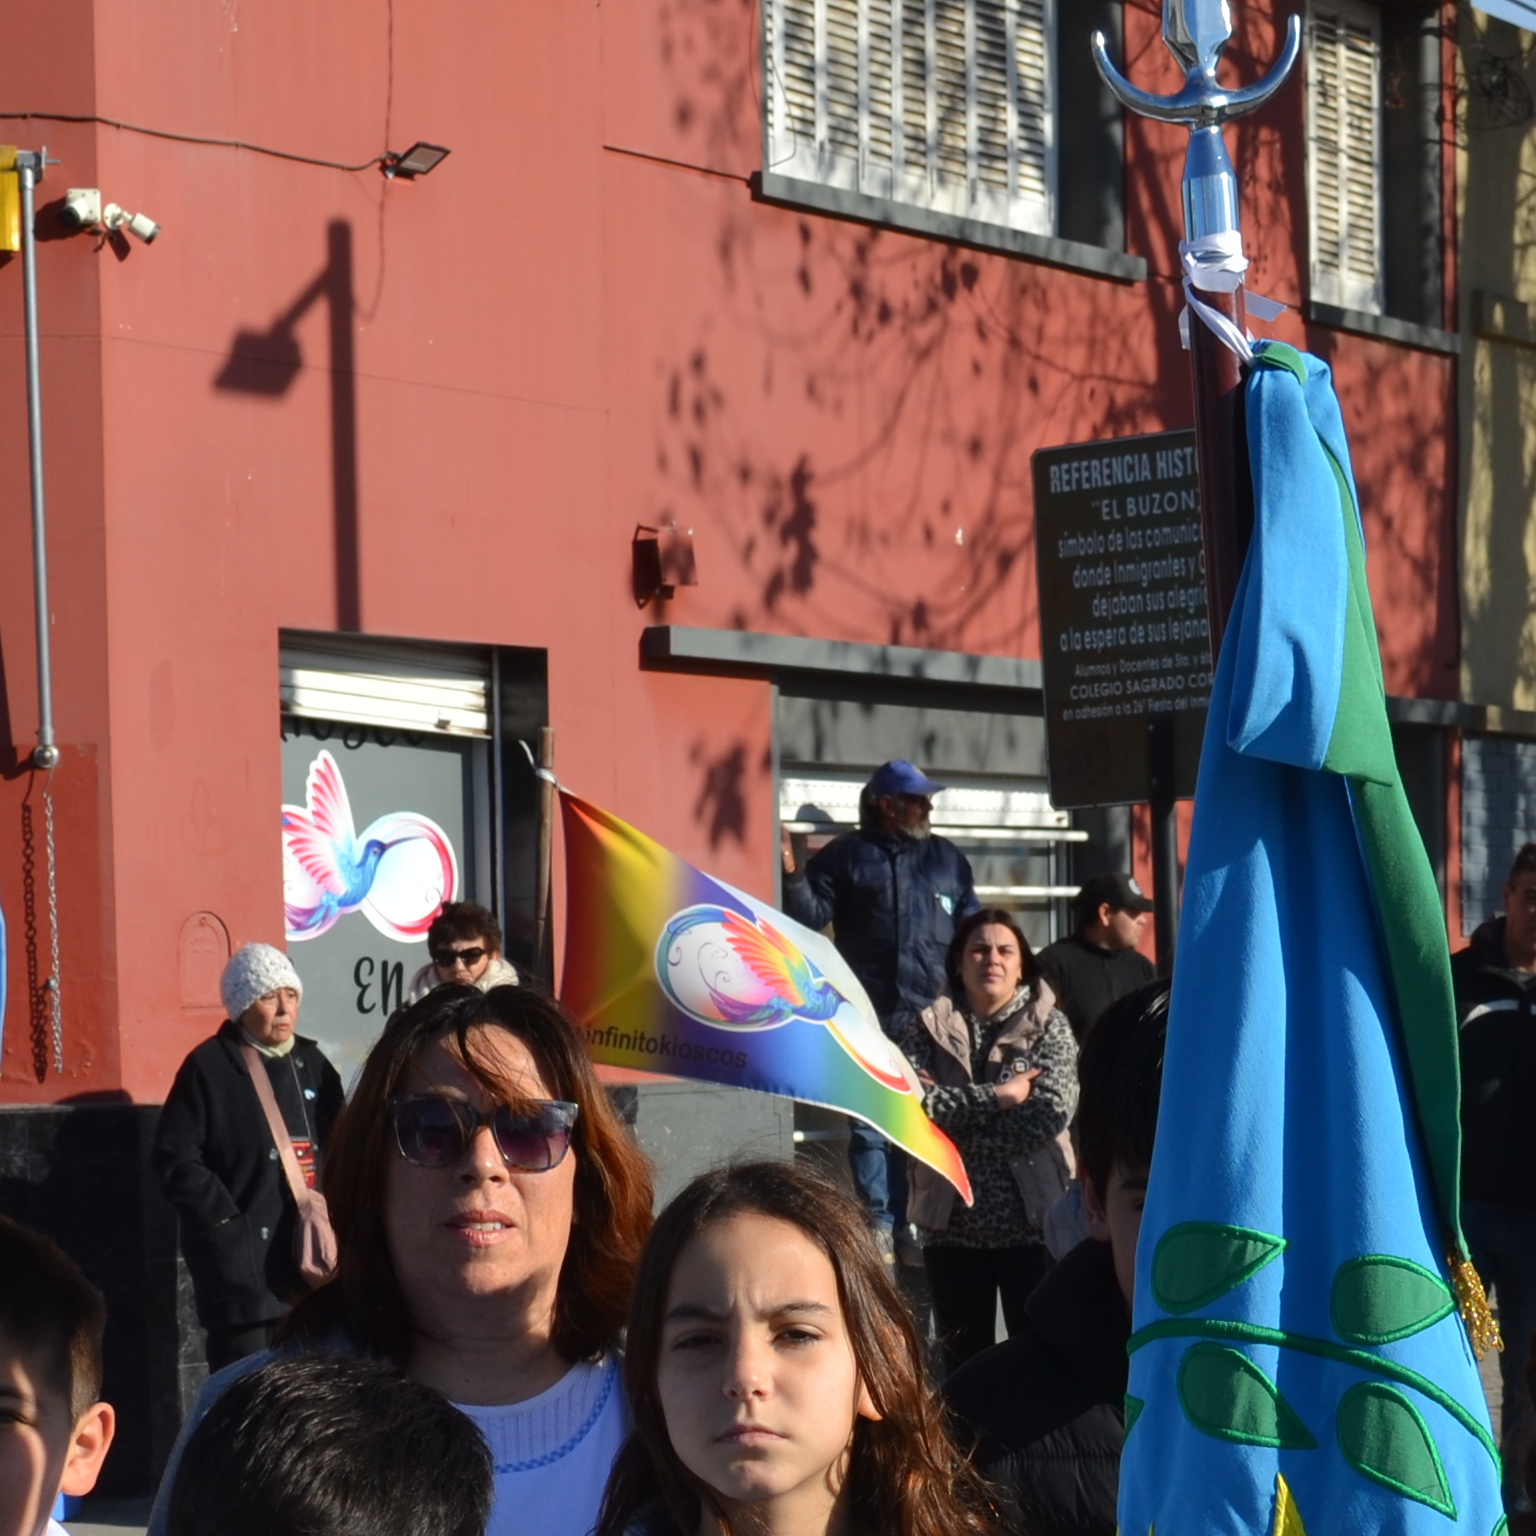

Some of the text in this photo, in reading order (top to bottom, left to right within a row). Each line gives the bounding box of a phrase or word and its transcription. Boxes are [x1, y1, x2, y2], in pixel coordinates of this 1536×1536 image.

[1049, 447, 1199, 493] REFERENCIA HIST
[1058, 530, 1105, 559] símbolo
[1107, 527, 1123, 551] de
[1125, 526, 1142, 549] las
[1072, 561, 1111, 588] donde
[1114, 553, 1185, 587] Inmigrantes
[1188, 556, 1195, 581] y
[1092, 590, 1143, 621] dejaban
[1146, 591, 1165, 612] sus
[1060, 632, 1067, 652] a
[1070, 627, 1082, 650] la
[1084, 626, 1126, 654] espera
[1129, 619, 1145, 644] de
[1148, 623, 1165, 643] sus
[1075, 663, 1110, 678] Alumnos
[1119, 656, 1159, 673] Docentes
[1161, 655, 1173, 668] de
[1193, 656, 1198, 668] y
[1070, 681, 1123, 700] COLEGIO
[1126, 675, 1185, 694] SAGRADO
[1062, 708, 1073, 721] en
[1075, 702, 1113, 719] adhesión
[1115, 705, 1121, 716] a
[1122, 701, 1131, 715] la
[1148, 697, 1173, 712] Fiesta
[1175, 696, 1189, 709] del
[578, 1025, 748, 1068] infinitokioscos
